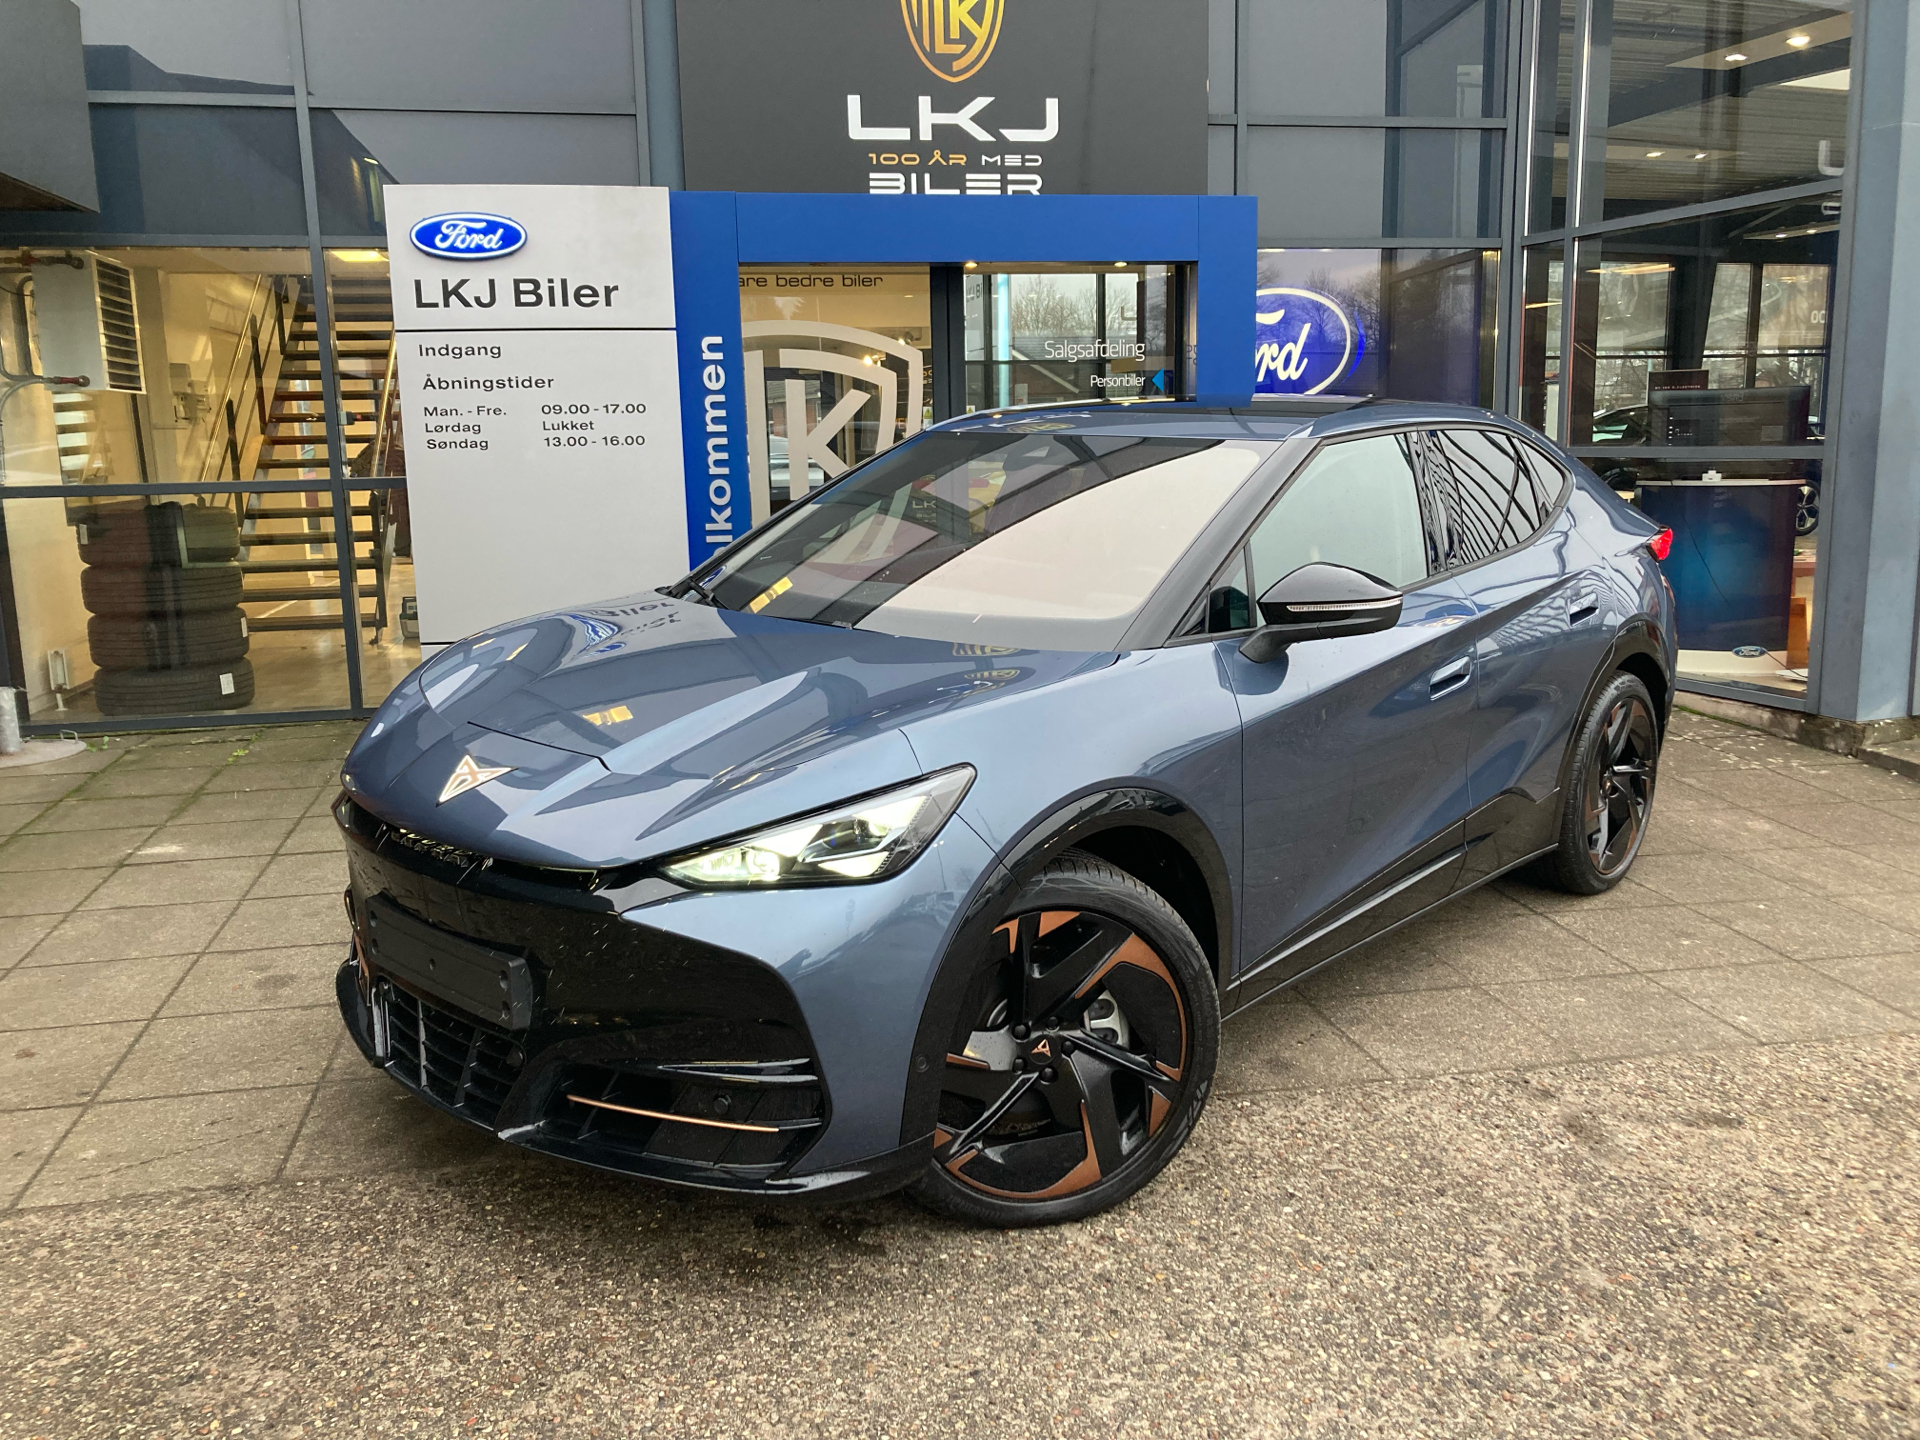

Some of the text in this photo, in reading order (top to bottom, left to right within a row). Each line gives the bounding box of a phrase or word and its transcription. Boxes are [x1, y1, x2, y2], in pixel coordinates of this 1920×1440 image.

[847, 94, 1059, 142] LKJ
[868, 149, 1042, 166] 100 ÅR MED
[869, 172, 1043, 195] BILER
[434, 220, 504, 250] Ford
[776, 274, 834, 288] bedre
[842, 274, 884, 288] biler
[414, 277, 619, 309] LKJ Biler
[418, 344, 501, 359] Indgang
[1044, 339, 1146, 363] Salgsafdeling
[422, 373, 554, 392] Åbningstider
[1090, 374, 1146, 387] Personbiler
[424, 406, 464, 417] Man.
[476, 405, 507, 416] Fre.
[541, 404, 590, 415] 09.00
[602, 403, 647, 414] 17.00
[425, 422, 482, 434] Lørdag
[542, 420, 595, 431] Lukket
[426, 438, 489, 450] Søndag
[543, 436, 588, 447] 13.00
[602, 435, 645, 446] 16.00
[701, 336, 733, 556] lkommen
